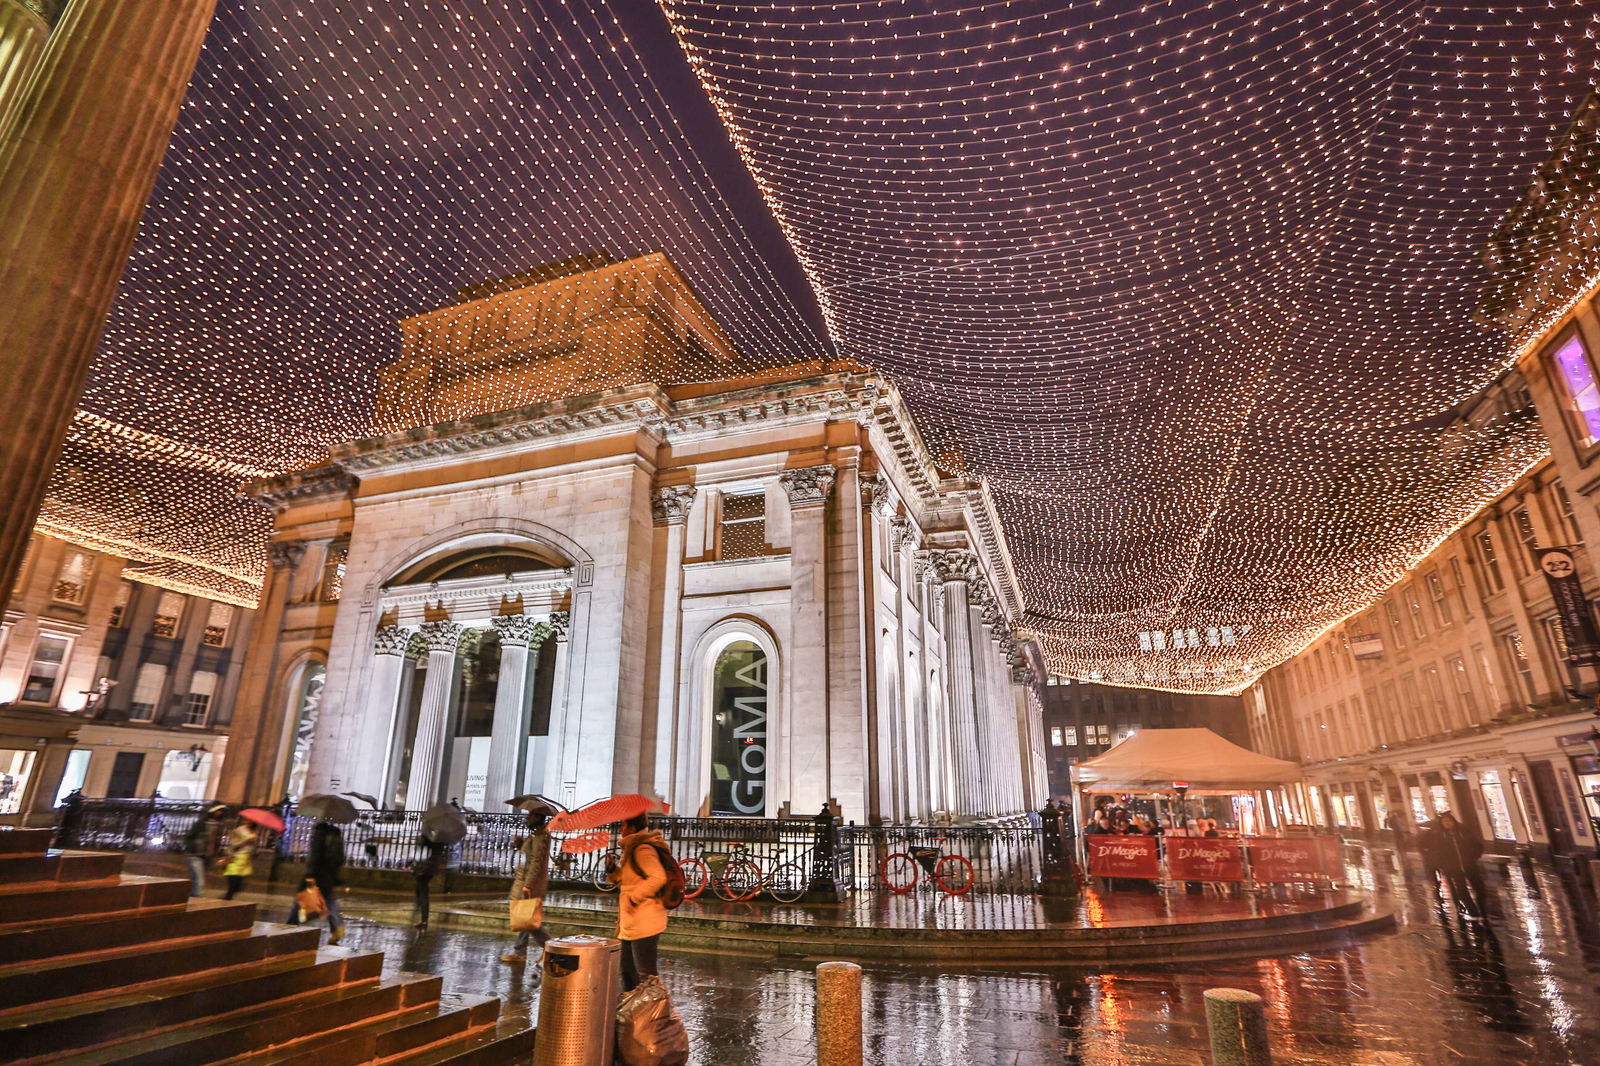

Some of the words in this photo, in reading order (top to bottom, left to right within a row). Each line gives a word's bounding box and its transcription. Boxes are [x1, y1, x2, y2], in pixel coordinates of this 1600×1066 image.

[731, 657, 767, 814] GoMA
[1097, 846, 1111, 857] Di
[1178, 848, 1191, 859] Di
